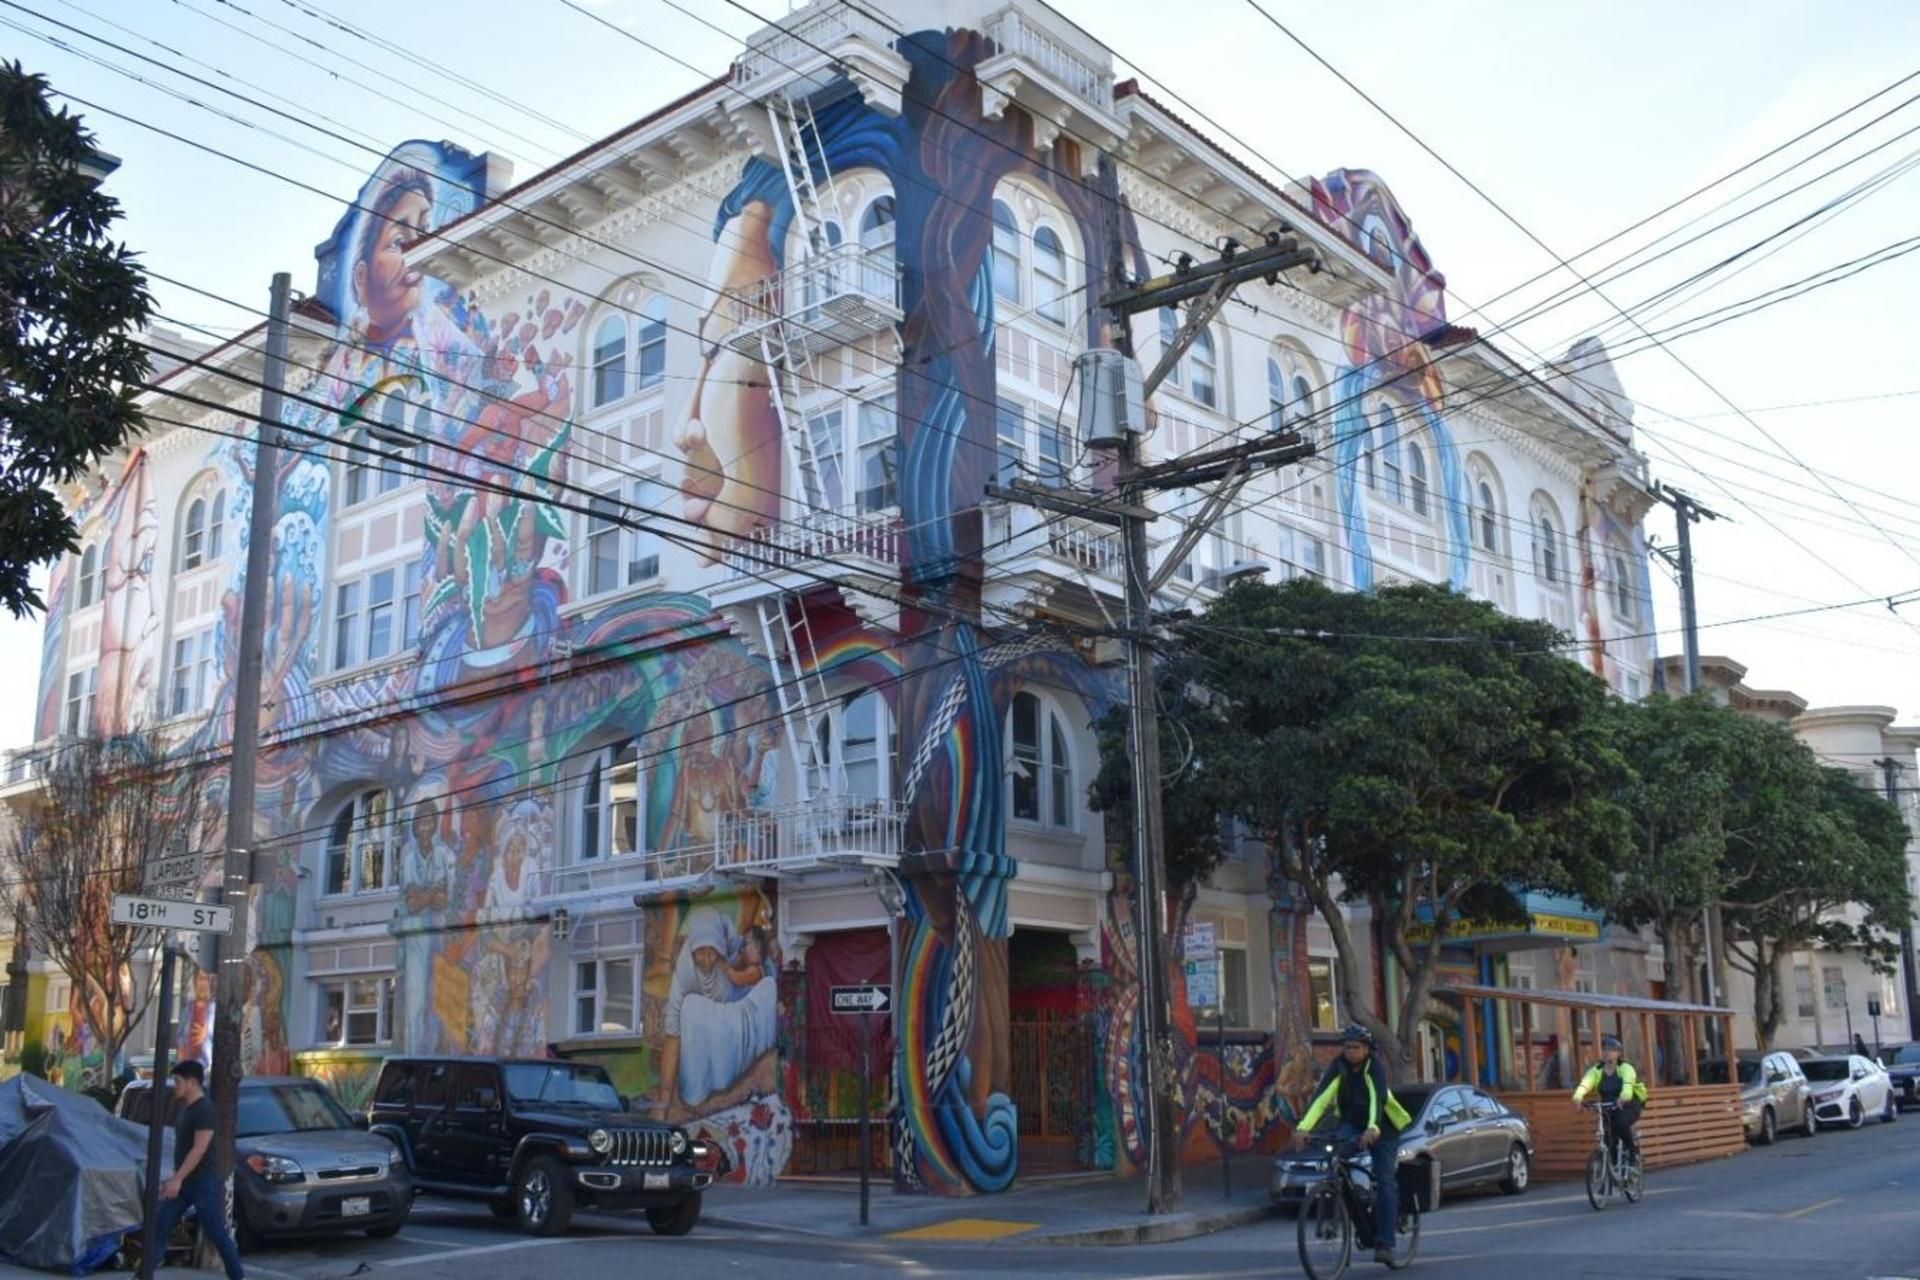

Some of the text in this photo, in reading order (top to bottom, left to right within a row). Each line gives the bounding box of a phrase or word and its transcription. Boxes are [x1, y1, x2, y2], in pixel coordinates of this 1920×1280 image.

[152, 858, 195, 880] LAPIDGE
[128, 903, 217, 926] 18TH ST
[837, 993, 873, 1006] ONE WAY
